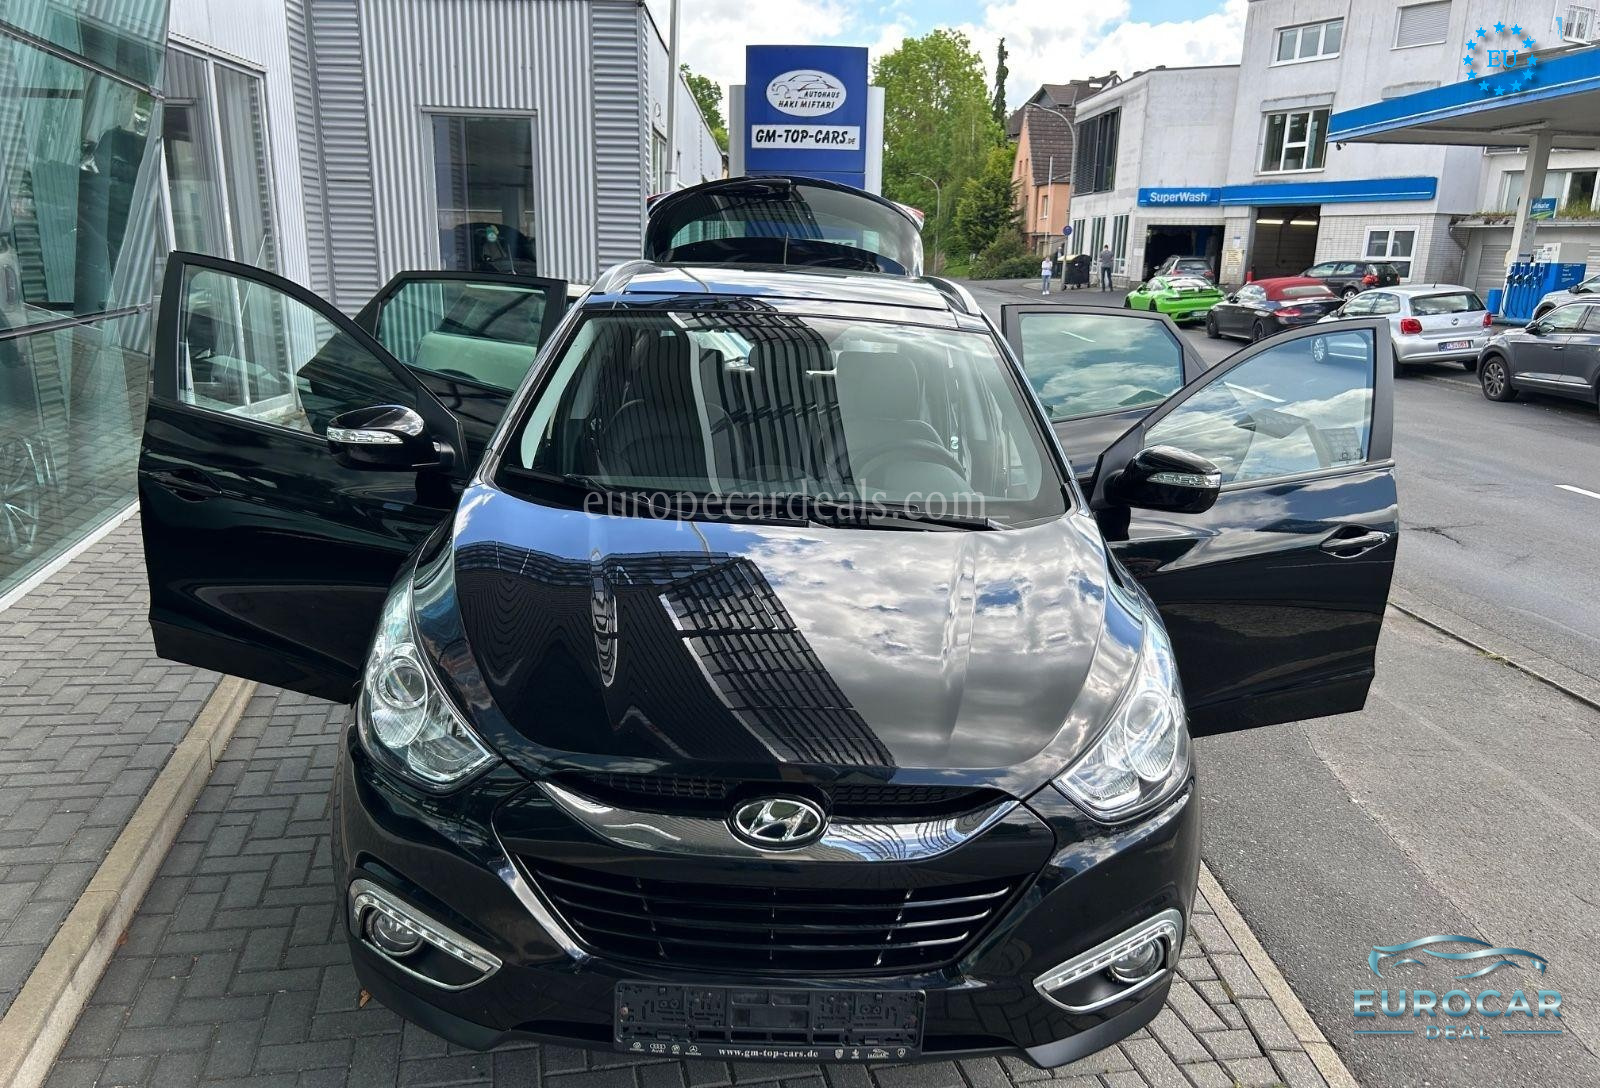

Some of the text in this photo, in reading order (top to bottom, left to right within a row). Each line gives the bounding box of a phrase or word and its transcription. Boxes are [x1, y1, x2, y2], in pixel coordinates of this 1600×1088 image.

[804, 91, 841, 99] AUTOHAUS
[801, 101, 835, 109] MIFTARI
[1150, 192, 1207, 203] SuperWash
[718, 1048, 819, 1059] www.gm-top-cars.de
